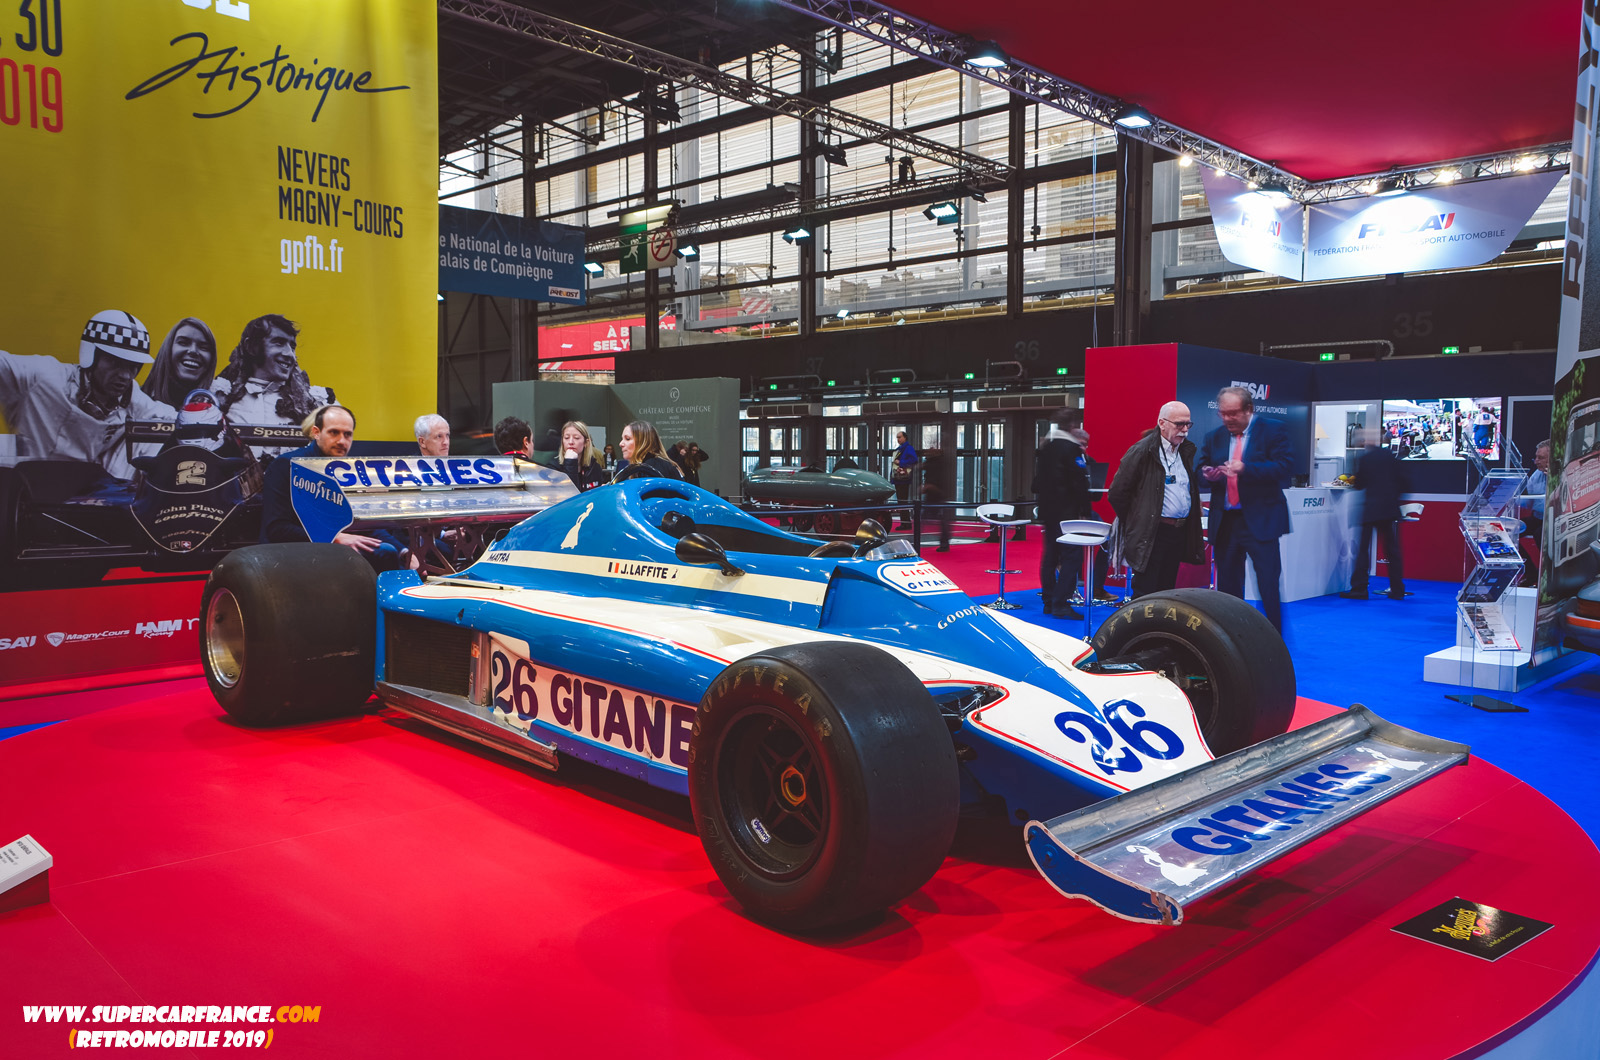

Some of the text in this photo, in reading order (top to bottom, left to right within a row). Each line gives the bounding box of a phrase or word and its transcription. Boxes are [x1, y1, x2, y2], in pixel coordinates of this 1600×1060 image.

[125, 32, 411, 122] Historique
[277, 145, 351, 191] NEVERS
[278, 185, 404, 239] MAGNY-COURS
[450, 232, 500, 255] National
[504, 241, 518, 257] de
[521, 243, 532, 259] la
[534, 246, 574, 265] Voiture
[1448, 229, 1506, 242] AUTOMOBILE
[280, 235, 344, 275] gpfh.fr
[473, 256, 488, 272] de
[490, 258, 554, 282] Compiègne
[1394, 311, 1434, 338] 35
[639, 405, 711, 415] CHÂTEAU DE COMPIÈGNE
[175, 460, 206, 485] 2
[325, 458, 503, 487] GITANES
[292, 474, 344, 506] GOODYEAR
[488, 552, 510, 563] MATRA
[620, 563, 669, 579] J.LAFFITE
[491, 650, 538, 721] 26
[1054, 699, 1185, 776] 26
[1171, 763, 1392, 856] GITANES
